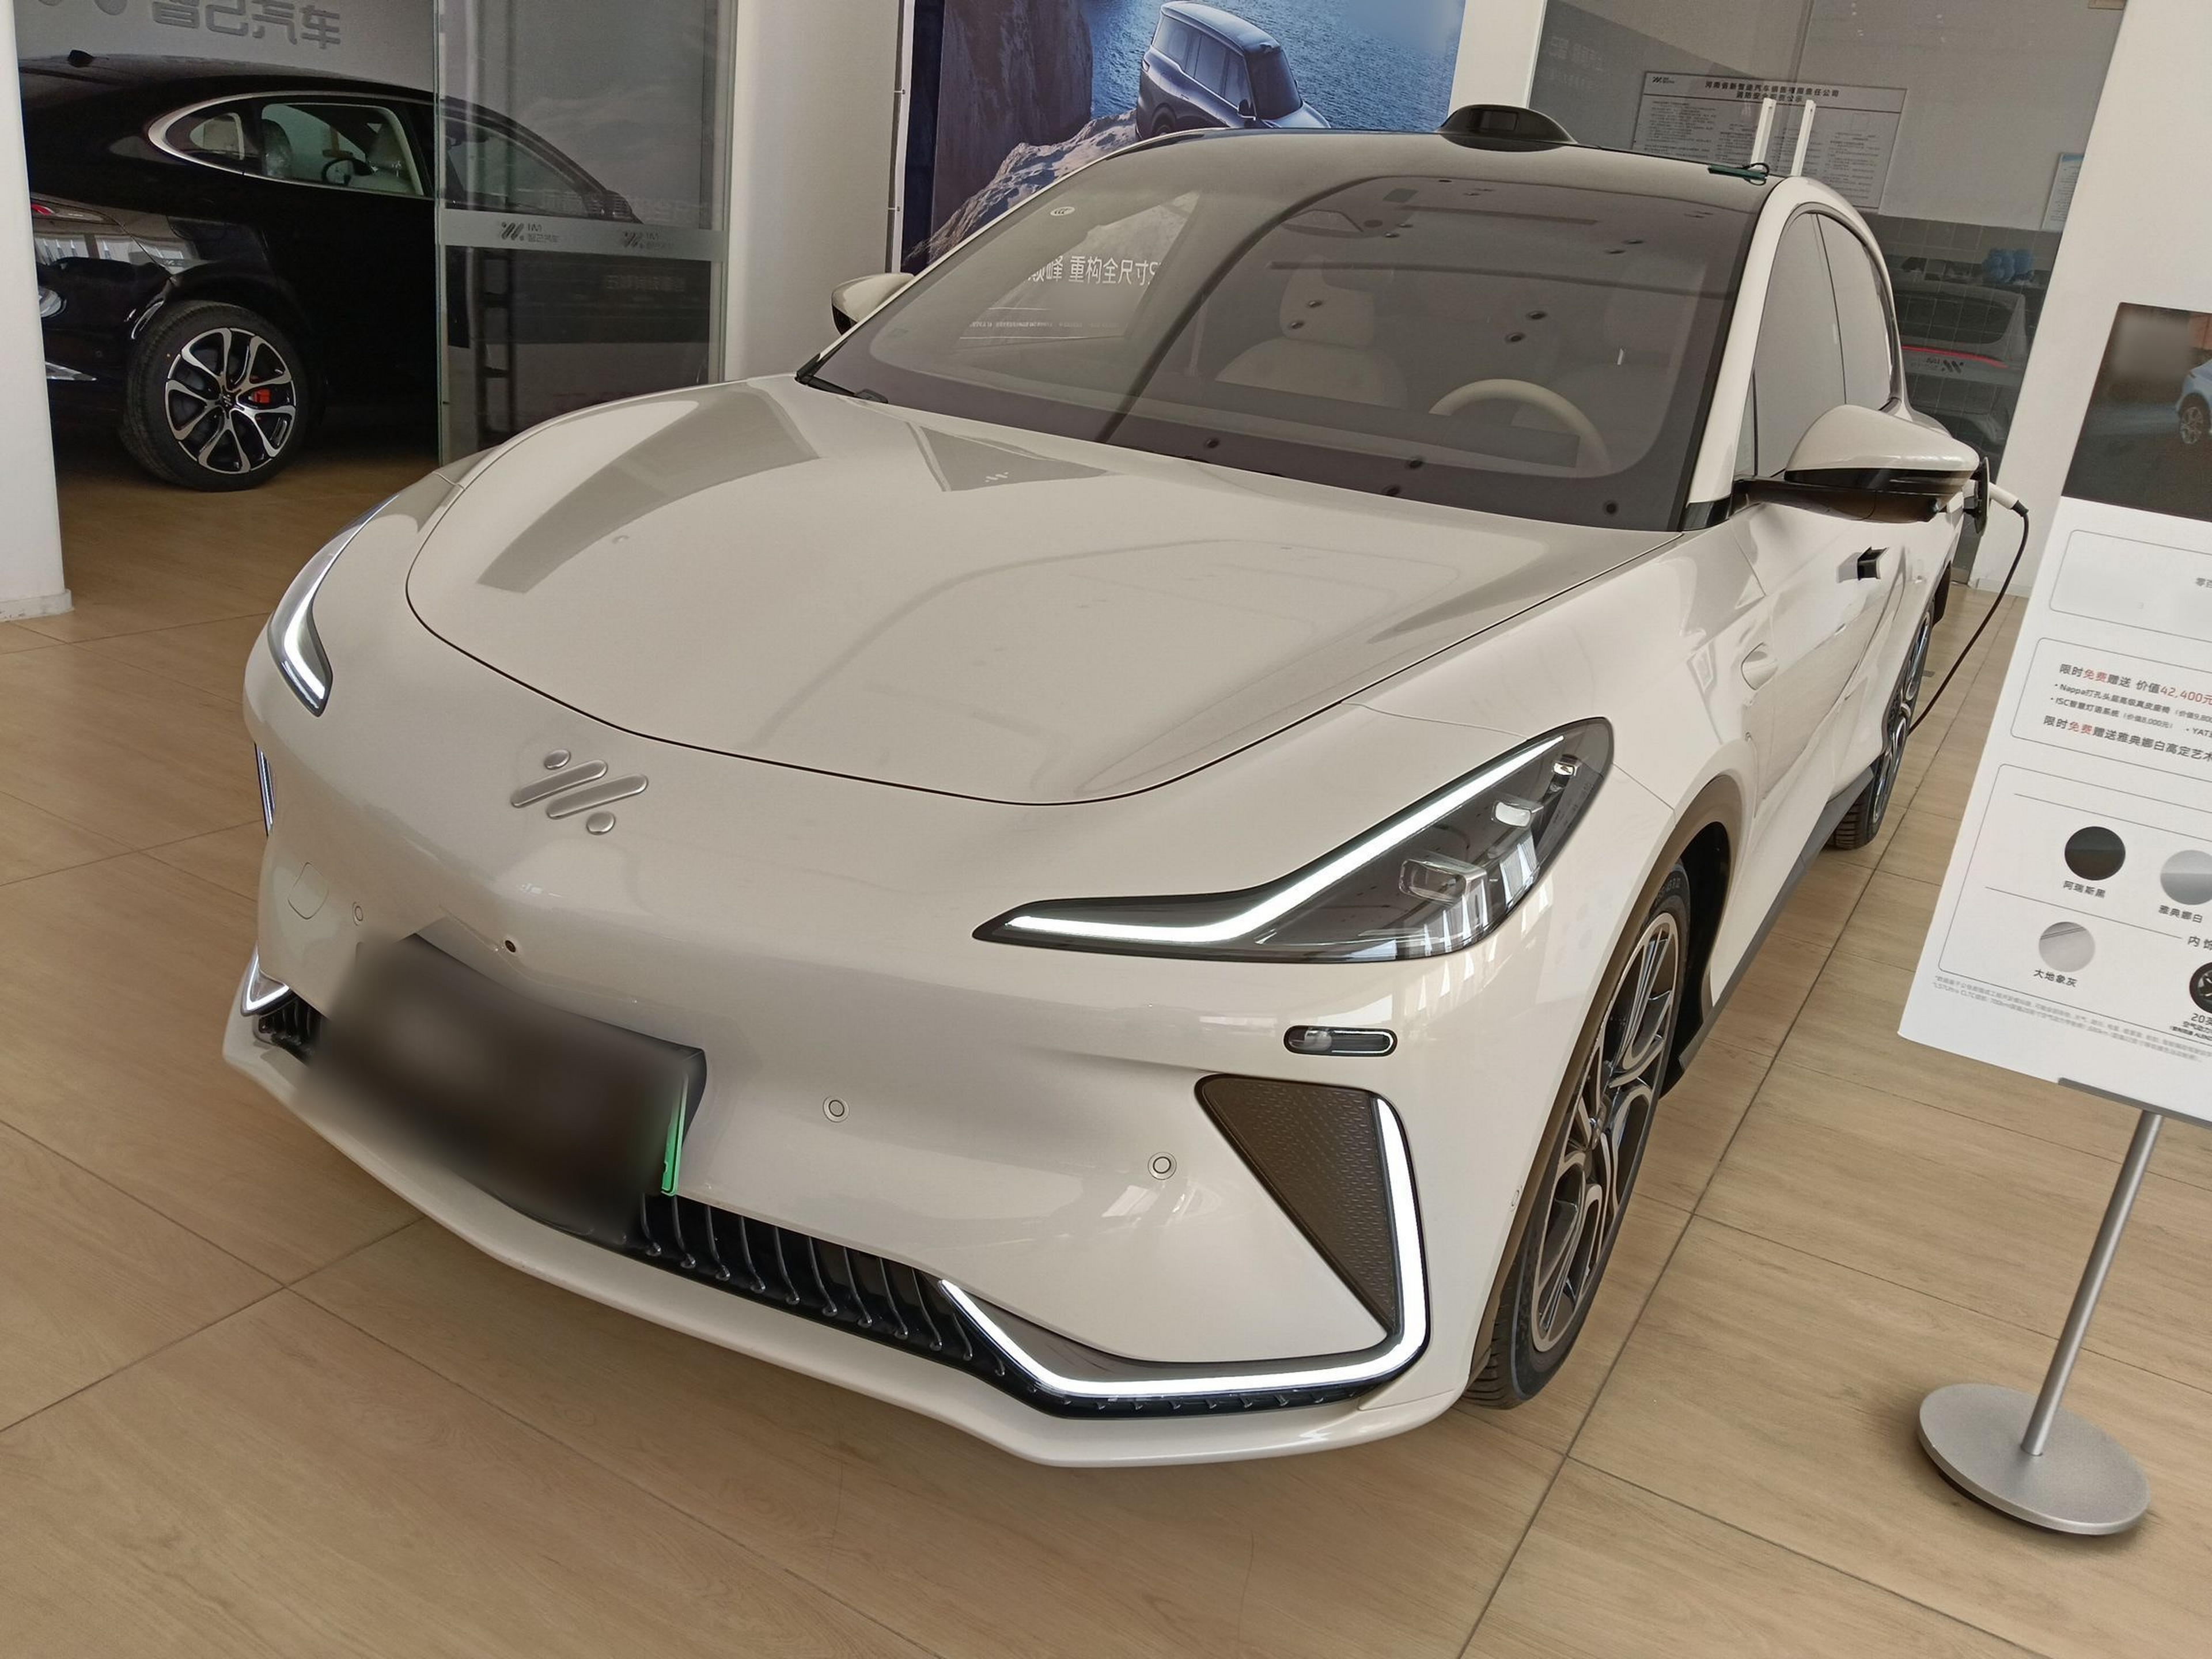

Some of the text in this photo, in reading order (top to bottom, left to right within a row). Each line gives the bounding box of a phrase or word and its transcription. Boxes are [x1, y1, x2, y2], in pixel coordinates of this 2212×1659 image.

[2059, 663, 2131, 688] 限时免费赠送
[2033, 968, 2078, 988] 大地象灰
